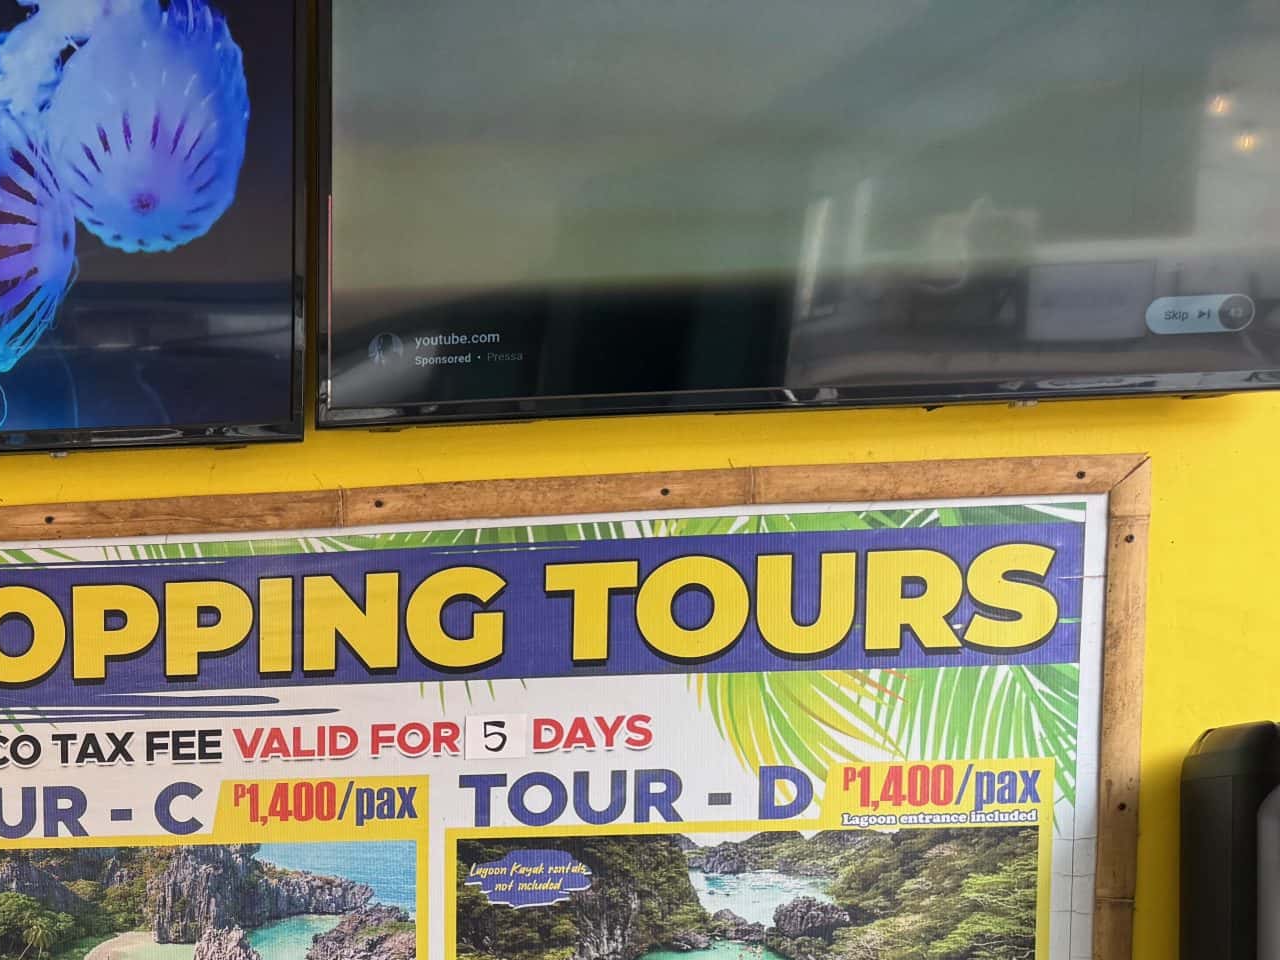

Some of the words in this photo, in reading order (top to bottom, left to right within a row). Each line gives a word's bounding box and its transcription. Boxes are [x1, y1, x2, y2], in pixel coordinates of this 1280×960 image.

[1164, 310, 1189, 321] Skip
[415, 332, 500, 349] youtube.com
[415, 354, 471, 367] Sponsored
[544, 543, 1060, 663] TOURS
[51, 732, 135, 765] TAX
[145, 729, 222, 762] FEE
[232, 724, 359, 759] VALID
[370, 720, 461, 757] FOR
[483, 720, 508, 752] 5
[532, 714, 653, 751] DAYS
[457, 768, 684, 826] TOUR
[757, 765, 814, 821] D
[152, 781, 204, 836] C
[842, 813, 897, 827] Lagoon
[898, 812, 968, 824] entrance
[970, 809, 1038, 823] included
[469, 862, 507, 878] Lagoon
[510, 862, 544, 876] Kayak
[548, 862, 586, 874] rentals
[494, 880, 513, 891] not
[518, 877, 563, 890] included
